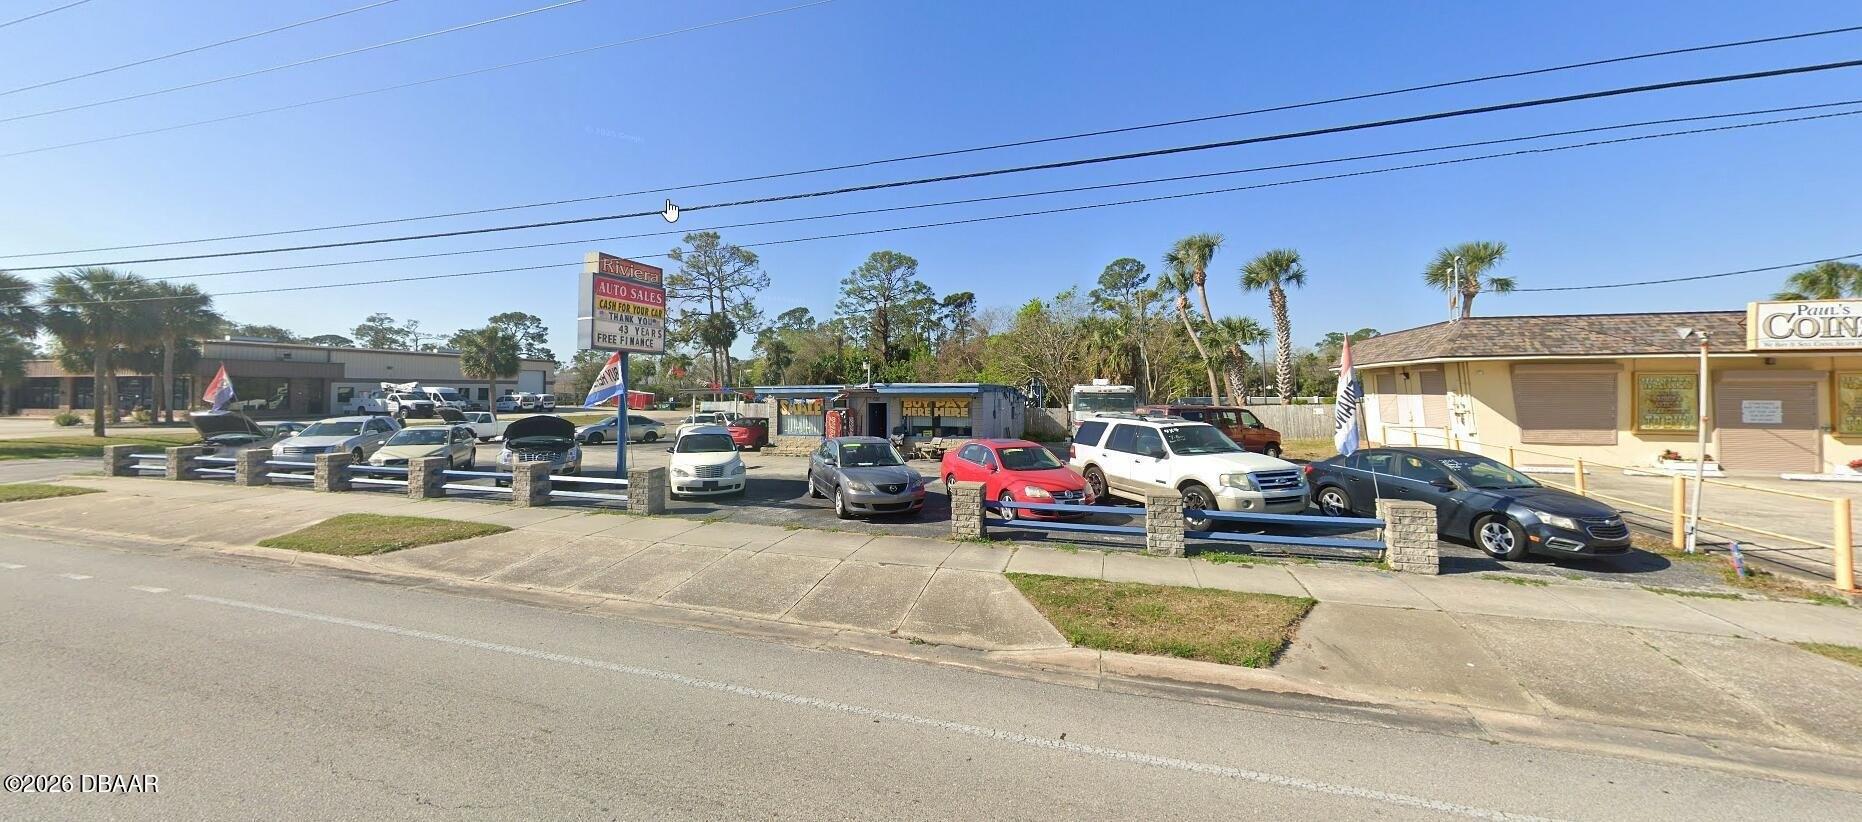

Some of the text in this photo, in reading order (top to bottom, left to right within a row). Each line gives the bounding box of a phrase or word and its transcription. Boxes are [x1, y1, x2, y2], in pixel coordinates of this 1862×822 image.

[602, 258, 659, 283] Riviera
[599, 282, 662, 304] AUTO SALES
[599, 299, 663, 318] CASH FOR YOUR CAR
[1797, 304, 1850, 316] Paul's
[609, 312, 634, 323] THANK
[618, 325, 663, 339] 43 YEARS
[1762, 312, 1862, 340] COIN
[597, 333, 654, 348] FREE FINANCE
[903, 398, 969, 408] BUY PAY
[902, 407, 931, 417] HERE
